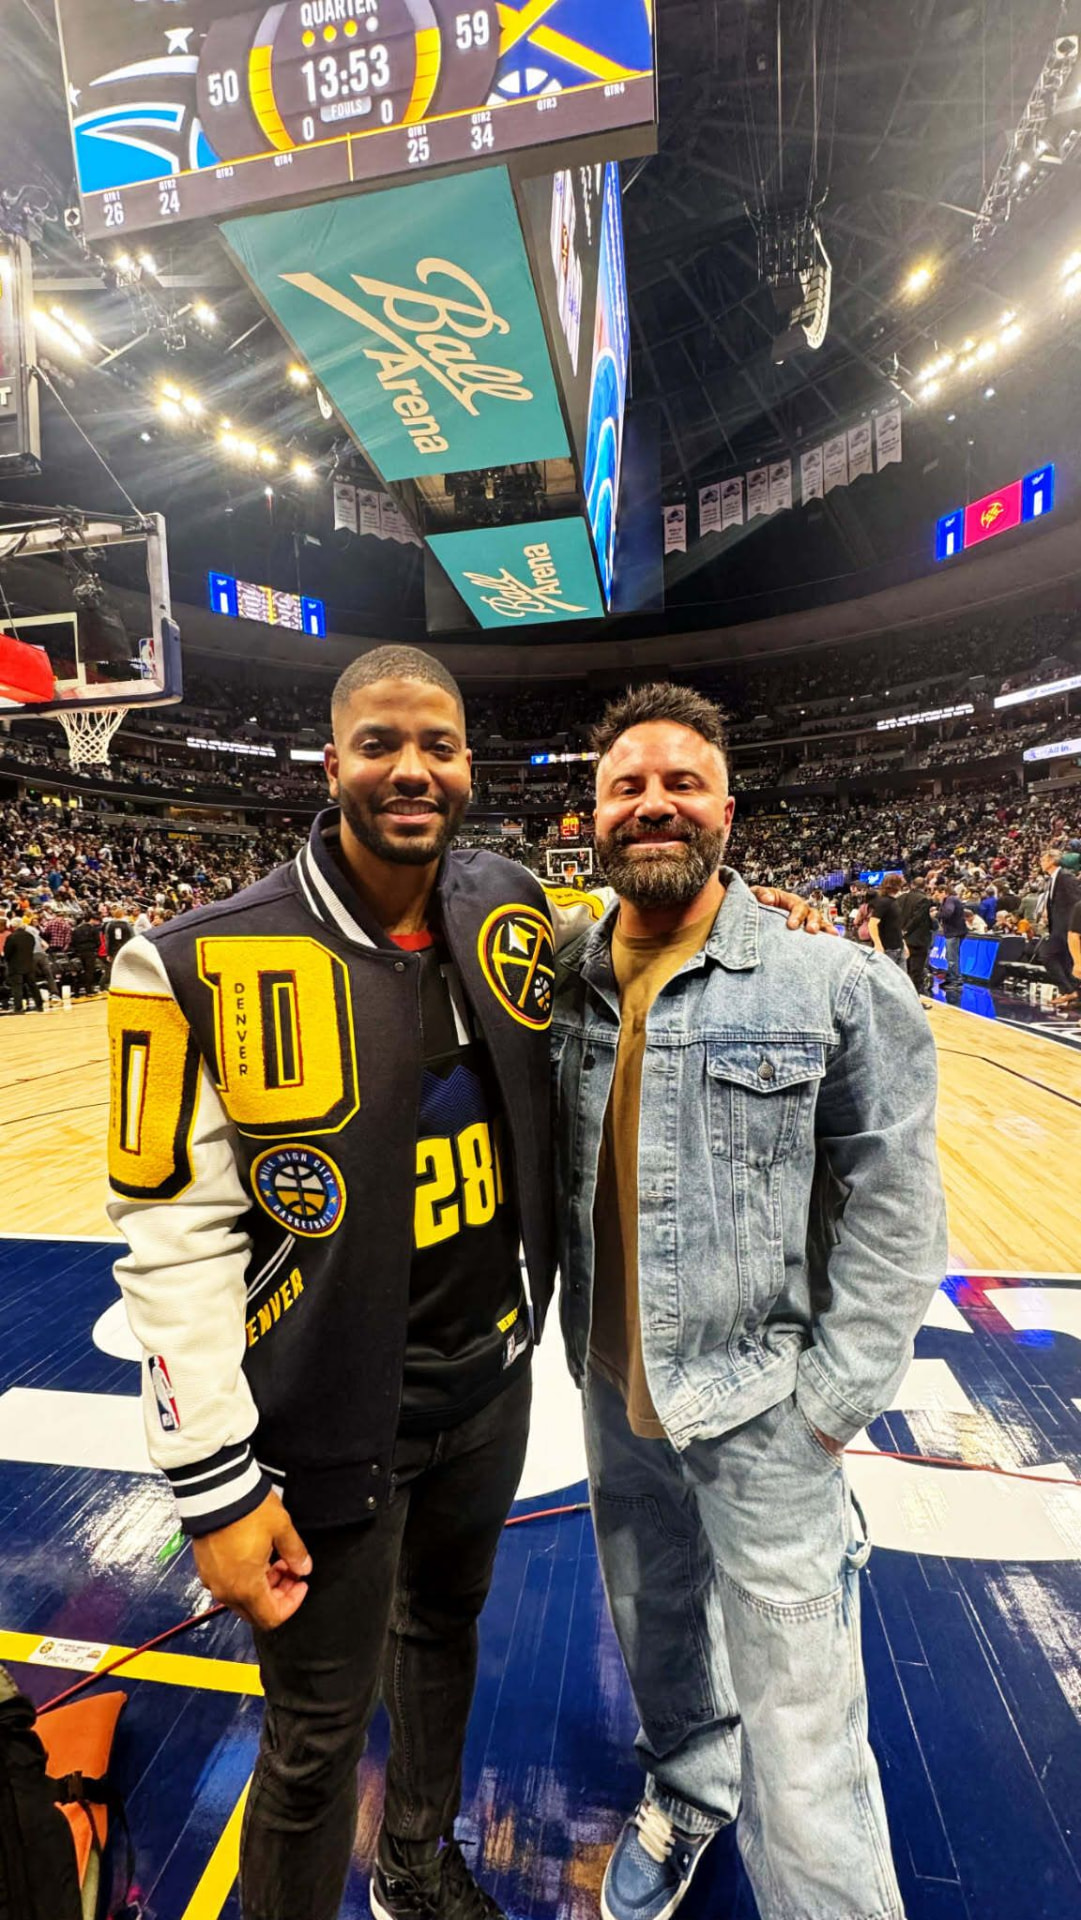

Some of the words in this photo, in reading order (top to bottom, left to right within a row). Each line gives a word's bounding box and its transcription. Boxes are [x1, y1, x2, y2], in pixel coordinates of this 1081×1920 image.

[456, 10, 490, 49] 59
[207, 69, 240, 106] 50
[301, 44, 390, 103] 13:53
[604, 82, 625, 97] QTR4
[331, 99, 364, 118] FOULS
[381, 98, 394, 125] 0
[471, 110, 491, 125] QTR2
[536, 97, 557, 112] QTR3
[302, 116, 315, 141] 0
[407, 124, 427, 138] QTR1
[471, 123, 495, 151] 34
[407, 136, 430, 164] 25
[103, 201, 125, 227] 26
[159, 190, 180, 216] 24
[278, 257, 534, 417] Ball
[362, 348, 449, 454] Arena
[523, 542, 563, 595] Arena
[462, 567, 590, 618] Ball
[234, 983, 248, 1076] DENVER
[259, 1160, 276, 1181] MILE
[313, 1159, 335, 1185] CITY
[413, 1122, 503, 1249] 28
[272, 1203, 334, 1230] BASKETBALL
[245, 1267, 304, 1348] ENVER
